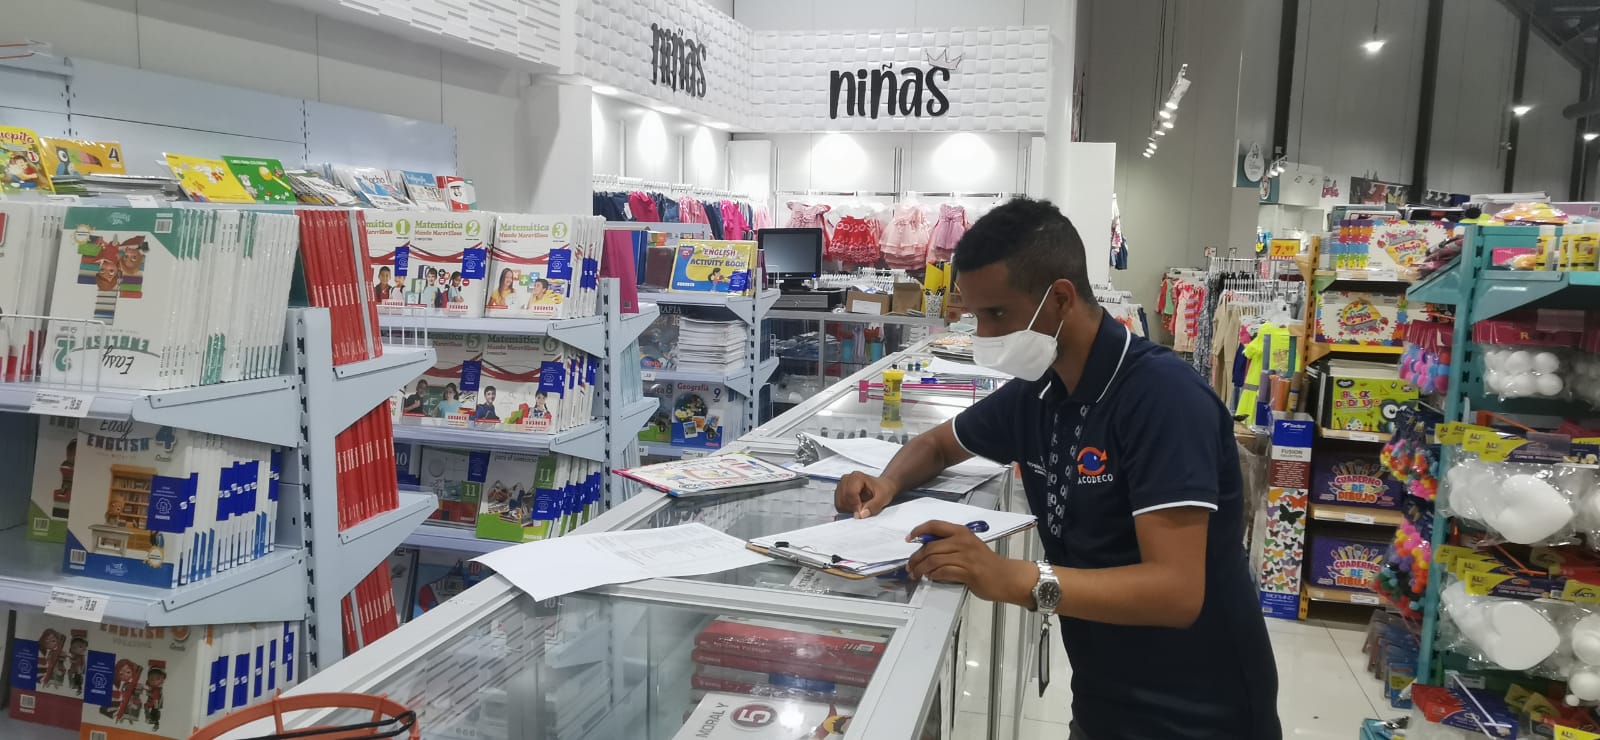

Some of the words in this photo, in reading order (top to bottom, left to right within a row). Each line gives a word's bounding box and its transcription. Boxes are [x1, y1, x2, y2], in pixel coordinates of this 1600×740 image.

[651, 22, 707, 98] niñas
[829, 62, 951, 119] niñas
[108, 147, 120, 162] 4
[415, 220, 463, 229] Matemática
[499, 222, 549, 232] Matemática
[704, 246, 737, 257] ENGLISH
[690, 258, 724, 267] ACTIVITY
[725, 259, 746, 268] BOOK
[102, 345, 135, 375] Easy
[677, 382, 709, 392] Geografía
[713, 388, 722, 398] 9
[99, 419, 134, 442] Easy
[87, 432, 150, 452] ENGLISH
[538, 468, 551, 482] 11
[1077, 474, 1114, 485] ACODECO
[1335, 475, 1382, 487] CUADERNO
[465, 484, 476, 497] 11
[1351, 484, 1364, 492] DE
[1338, 491, 1377, 502] DIBUJO
[1350, 569, 1364, 577] DE
[737, 708, 771, 723] 5
